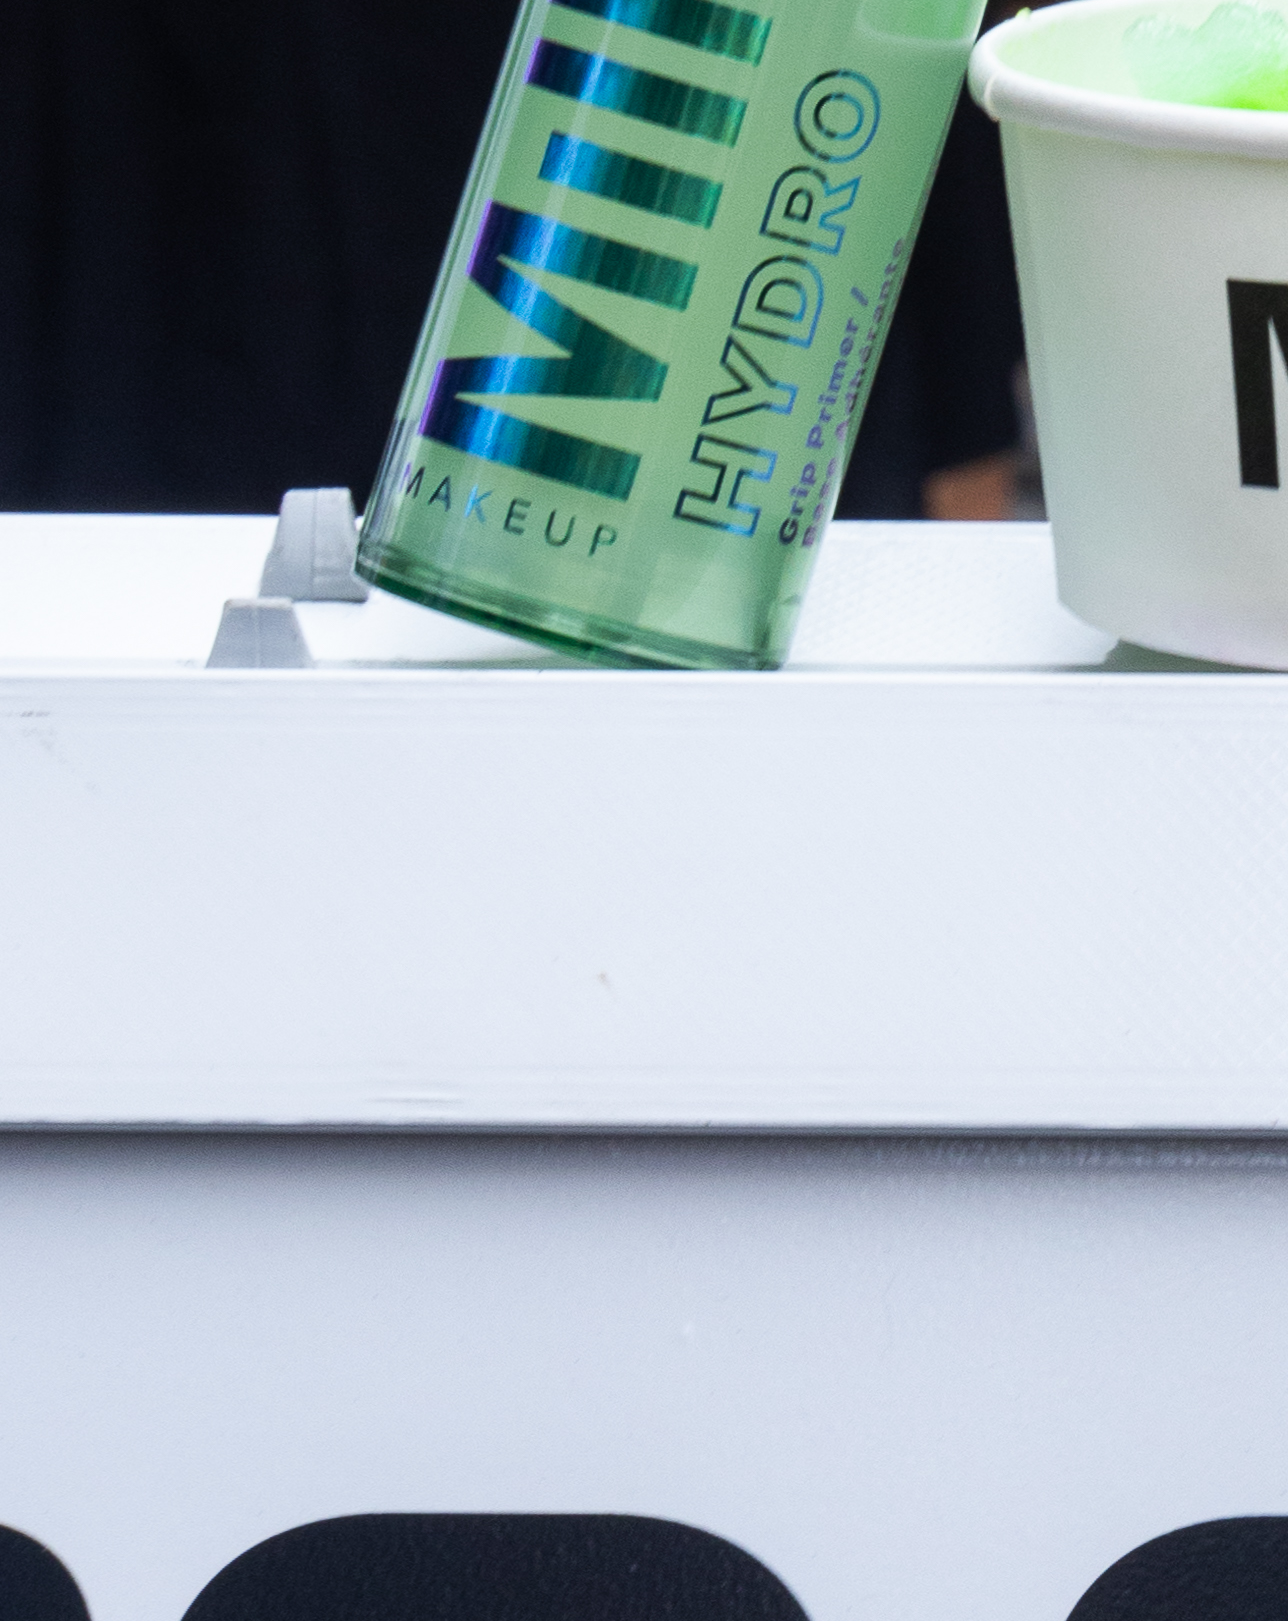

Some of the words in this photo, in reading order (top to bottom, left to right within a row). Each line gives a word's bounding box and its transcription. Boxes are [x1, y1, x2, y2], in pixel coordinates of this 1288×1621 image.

[674, 68, 881, 538] HYDRO
[400, 462, 619, 558] MAKEUP
[778, 461, 817, 546] Grip
[805, 317, 860, 449] Primer
